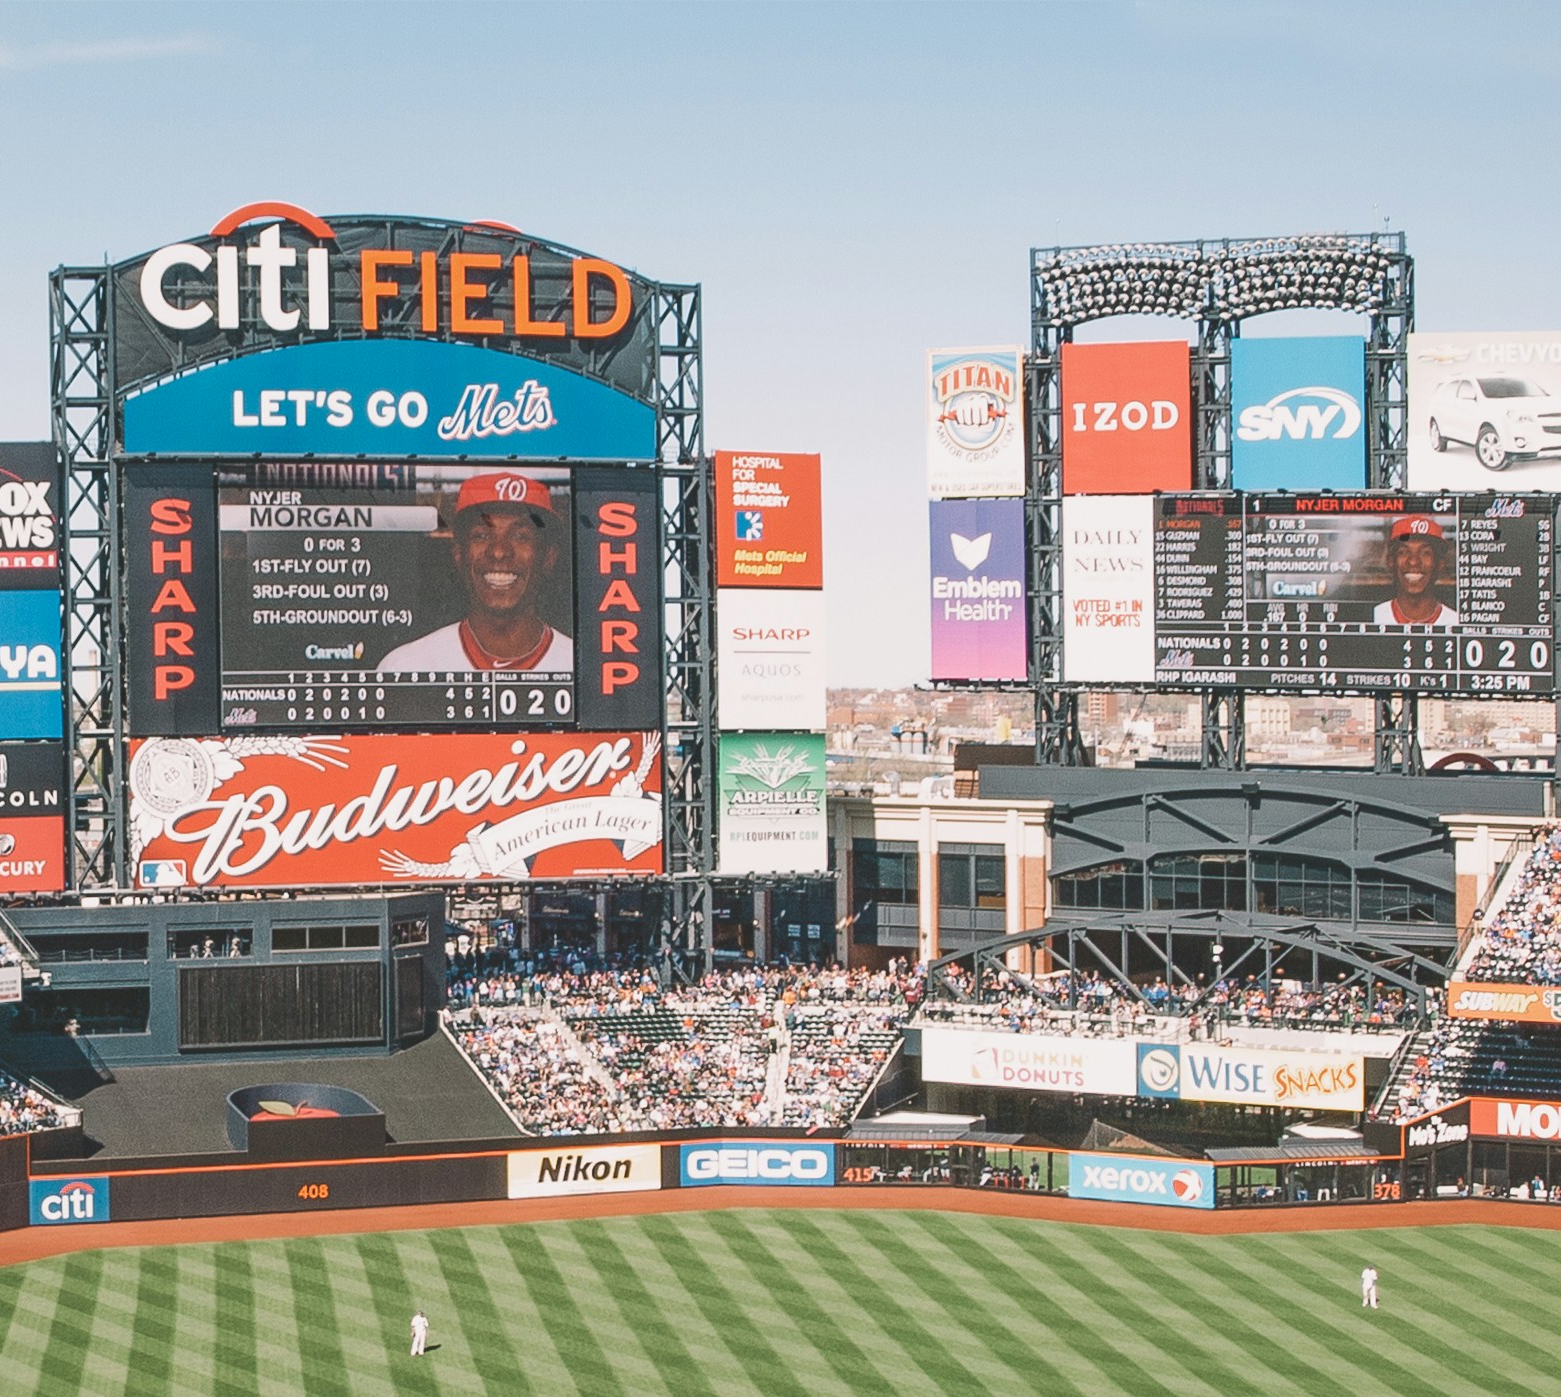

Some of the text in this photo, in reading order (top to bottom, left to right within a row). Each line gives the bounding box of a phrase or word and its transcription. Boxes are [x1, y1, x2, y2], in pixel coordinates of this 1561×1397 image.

[140, 224, 633, 339] citi FIELD
[939, 364, 1010, 396] TITAN
[232, 380, 554, 440] LET'S GO Mets
[1073, 401, 1180, 432] IZOD
[1237, 403, 1338, 441] SNY
[732, 456, 783, 470] HOSPITAL
[732, 469, 755, 481] FOR
[732, 482, 782, 495] SPECIAL
[249, 491, 302, 505] NYJER
[1296, 499, 1404, 511] NYJER MORGAN
[250, 507, 373, 528] MORGAN
[319, 539, 346, 551] FOR
[766, 550, 807, 563] Official
[252, 559, 371, 576] 1ST-FLY OUT (7)
[735, 563, 783, 577] Hospital
[252, 584, 366, 599] 3RD-FOUL OUT
[932, 577, 1022, 598] Emblem
[150, 498, 196, 700] SHARP
[598, 502, 640, 694] SHARP
[252, 610, 378, 625] 5TH-GROUNDOUT
[944, 600, 1009, 622] Health
[1075, 614, 1141, 627] NY SPORTS
[732, 628, 810, 641] SHARP
[1157, 638, 1221, 649] NATIONALS
[741, 664, 802, 678] AQUOS
[1393, 673, 1531, 690] 10 3:25 PM
[222, 688, 286, 701] NATIONALS
[164, 738, 631, 884] Budweiser
[494, 805, 653, 856] American Lager
[1453, 989, 1539, 1014] SUBWAY
[1002, 1065, 1085, 1087] DONUTS
[1273, 1062, 1359, 1101] SNACKS
[537, 1155, 633, 1184] Nikon
[685, 1147, 830, 1181] GEICO
[843, 1167, 872, 1182] 415
[1082, 1164, 1167, 1194] xerox
[297, 1183, 329, 1200] 408
[1373, 1184, 1401, 1199] 378
[41, 1186, 93, 1221] citi
